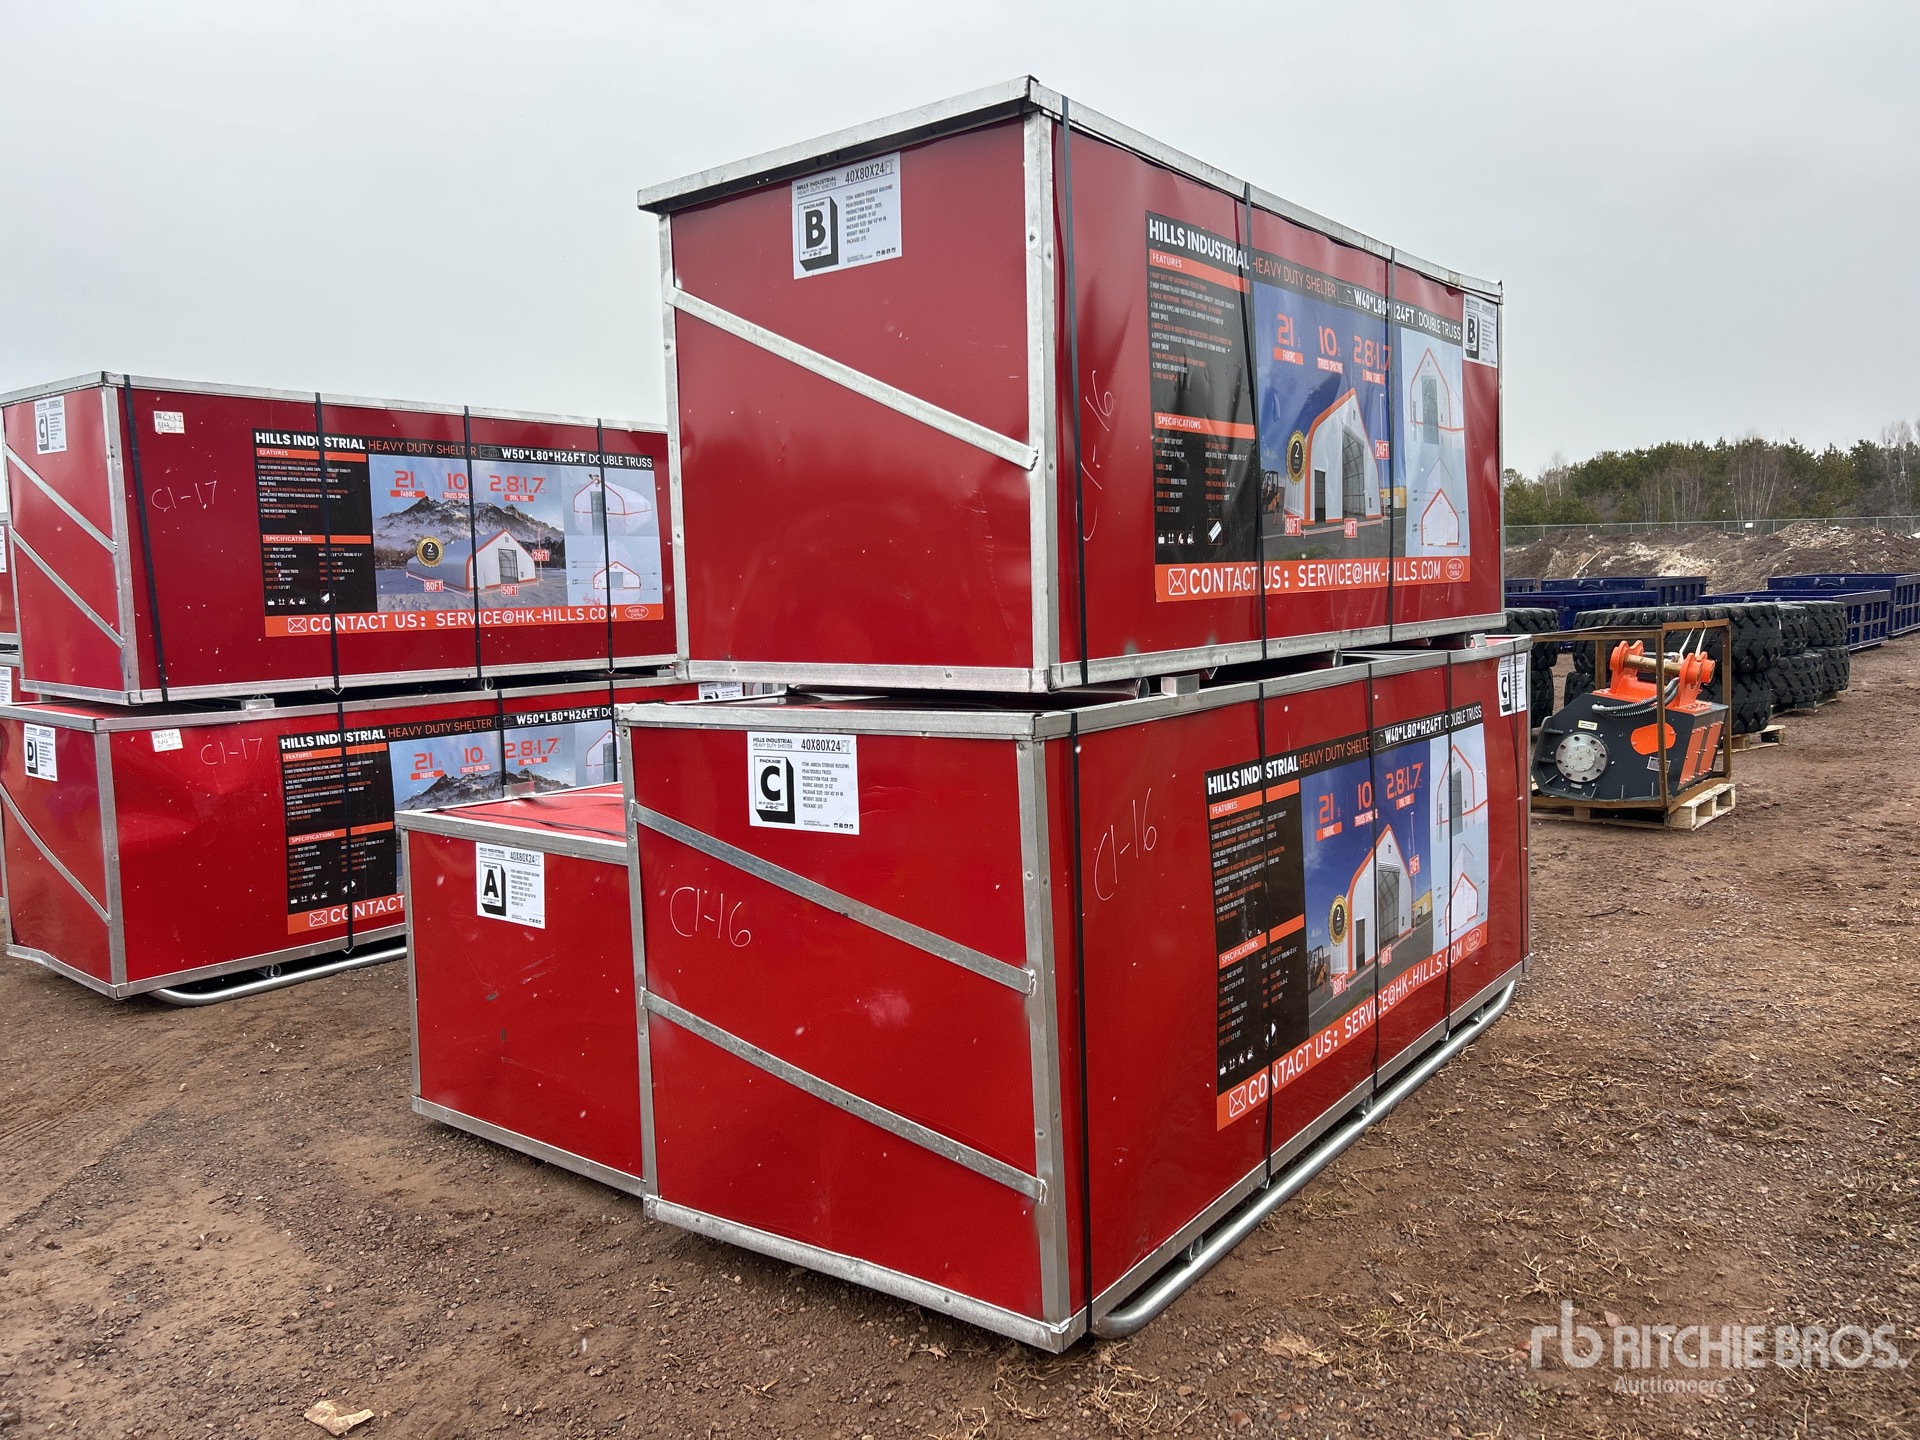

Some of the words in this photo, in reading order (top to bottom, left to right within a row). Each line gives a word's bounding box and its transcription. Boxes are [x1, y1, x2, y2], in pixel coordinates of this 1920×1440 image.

[810, 176, 836, 187] INDUSTRIAL
[803, 202, 825, 210] PACKAGE
[805, 210, 826, 249] B
[1153, 253, 1182, 269] FEATURES
[1150, 219, 1185, 248] HILLS
[1188, 230, 1250, 270] INDUSTRIAL
[1253, 257, 1281, 279] HEAVY
[1284, 266, 1304, 288] DUTY
[1306, 275, 1337, 299] SHELTER
[1419, 312, 1440, 334] DOUBLE
[1442, 322, 1461, 340] TRUSS
[1277, 313, 1294, 347] 21
[1319, 326, 1337, 357] 10
[1468, 318, 1476, 344] B
[39, 419, 46, 439] C
[1158, 416, 1201, 430] SPECIFICATIONS
[256, 432, 291, 446] HILLS
[368, 440, 404, 452] HEAVY
[407, 443, 433, 454] DUTY
[437, 445, 477, 456] SHELTR
[589, 454, 624, 466] DOUBLE
[625, 457, 653, 468] TRUSS
[1295, 443, 1300, 458] 2
[1376, 443, 1389, 458] 24FT
[395, 470, 415, 489] 21
[447, 473, 468, 491] 10
[152, 480, 218, 511] C1-17
[1286, 517, 1300, 535] 80FT
[428, 543, 434, 552] 2
[534, 551, 549, 560] 26FT
[426, 582, 442, 591] 80FT
[1190, 567, 1258, 594] CONTACT
[1264, 566, 1289, 589] US:
[1298, 560, 1441, 588] SERVICE@HK-HILLS.COM
[503, 586, 518, 595] 50FT
[310, 615, 388, 632] CONTACT
[395, 615, 426, 628] US:
[436, 608, 618, 627] SERVICE@HK-HILLS.COM
[1502, 677, 1508, 699] C
[281, 736, 315, 750] HILLS
[388, 726, 423, 738] HEAVY
[426, 723, 451, 734] DUTY
[455, 719, 493, 732] SHELTER
[28, 742, 34, 762] D
[201, 738, 263, 765] C1-17
[414, 752, 434, 771] 21
[464, 747, 484, 764] 10
[1208, 771, 1240, 796] HILLS
[1300, 749, 1324, 770] HEAVY
[1326, 744, 1345, 761] DUTY
[1347, 737, 1370, 756] SHELTE
[1445, 709, 1466, 729] DOUBLE
[1466, 705, 1482, 721] TRUSS
[761, 766, 781, 802] C
[1357, 781, 1373, 811] 10
[1212, 801, 1238, 815] FEATURES
[1318, 792, 1335, 825] 21
[291, 831, 336, 843] SPECIFICATIONS
[1094, 788, 1158, 901] C1-16
[484, 869, 499, 899] A
[331, 896, 405, 923] CONTACT
[670, 886, 752, 948] C1-16
[1337, 907, 1341, 921] 2
[1222, 940, 1258, 964] SPECIFICATIONS
[1334, 974, 1346, 996] 80FT
[1249, 1043, 1313, 1105] CONTACT
[1316, 1030, 1338, 1059] US:
[1345, 940, 1463, 1039] SERVICE@HK-HILLS.COM
